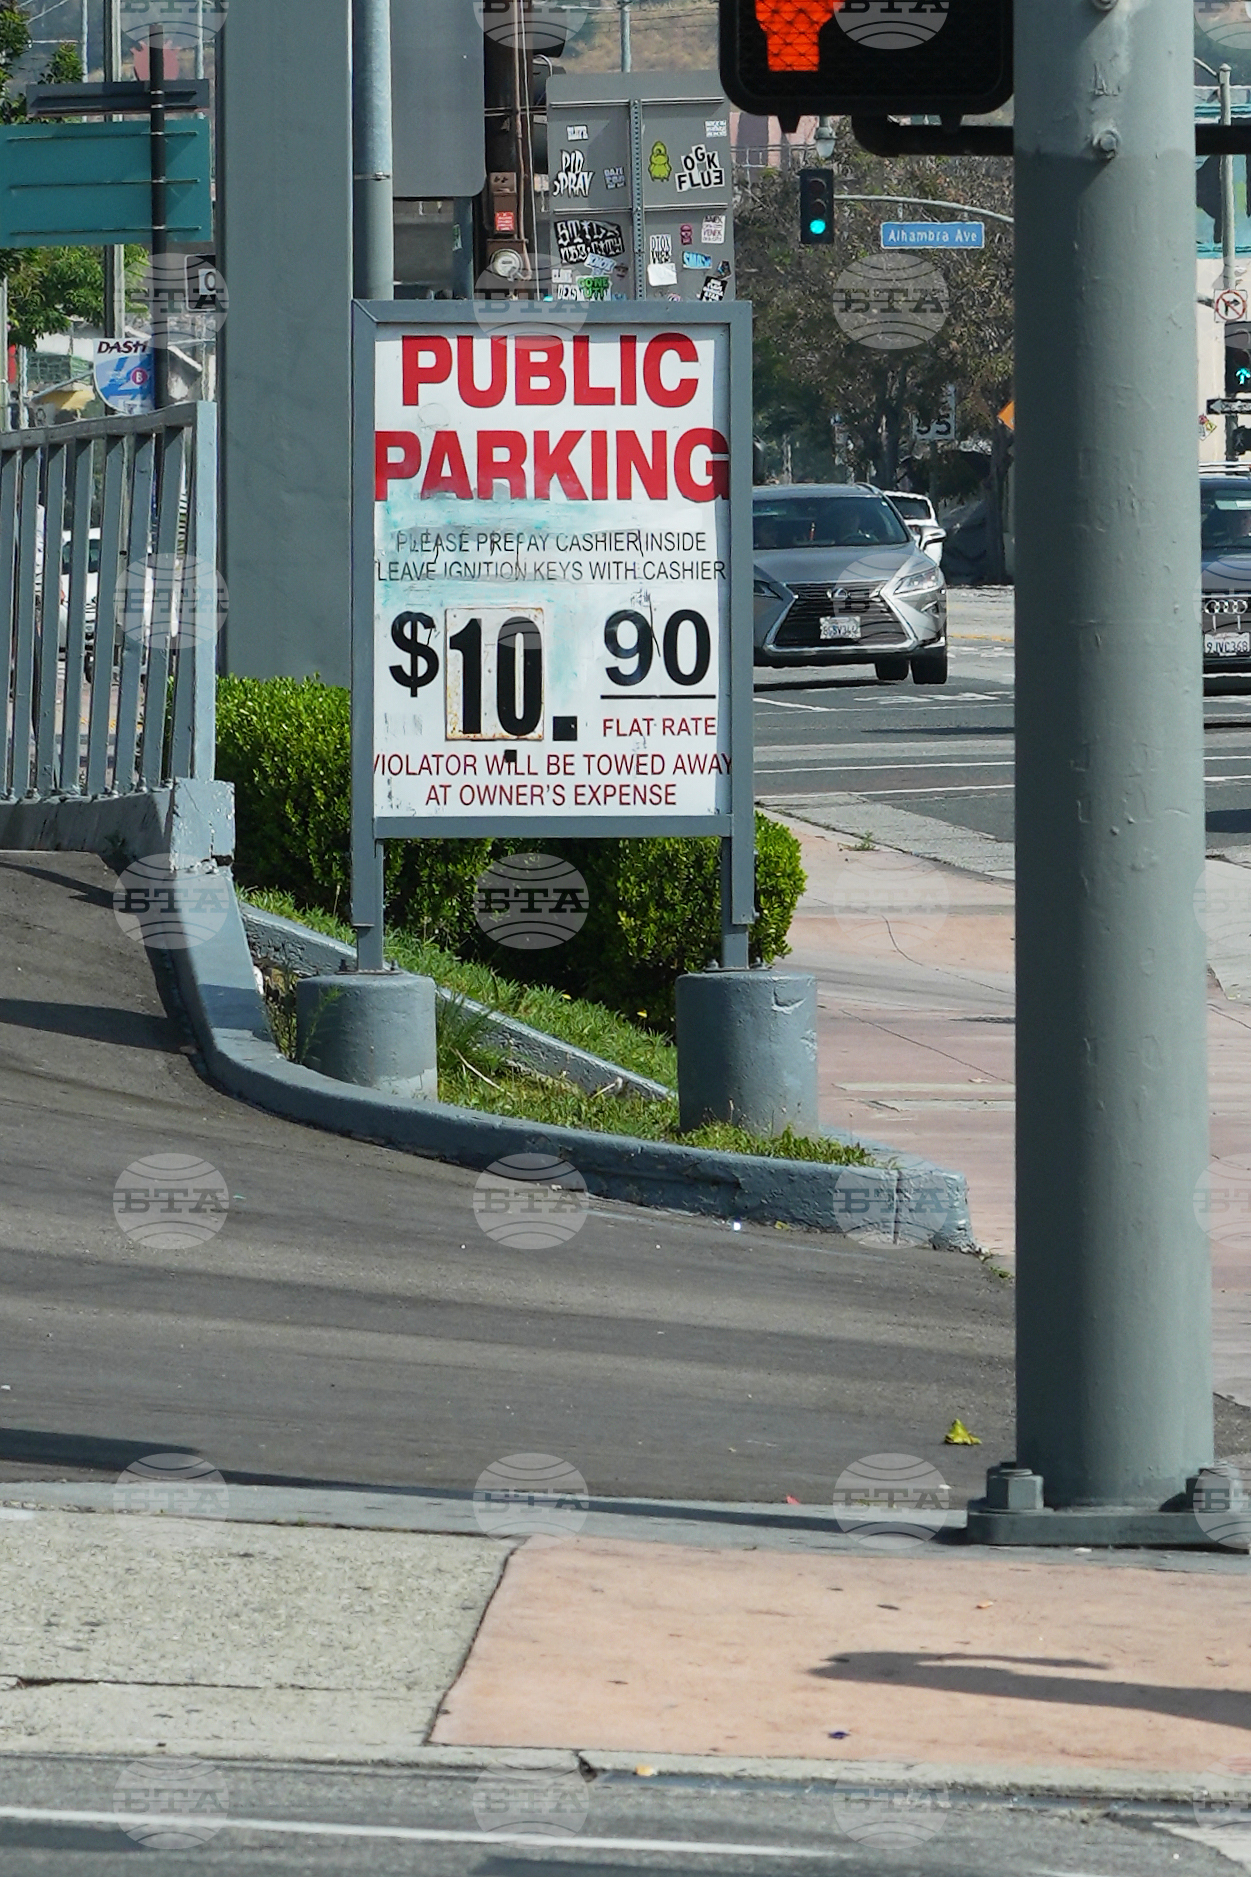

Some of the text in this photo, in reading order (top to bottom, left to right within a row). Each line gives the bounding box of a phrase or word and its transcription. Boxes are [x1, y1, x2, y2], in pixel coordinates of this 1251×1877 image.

[887, 229, 977, 242] Alhambra Ave
[97, 340, 149, 355] DASH
[402, 333, 701, 407] PUBLIC
[374, 427, 730, 504] PARKING
[396, 531, 470, 553] PLEASE
[556, 531, 639, 552] CASHIER
[645, 531, 707, 552] INSIDE
[377, 560, 726, 581] LEAVE IGNITION KEYS WITH CASHIER
[602, 717, 718, 737] FLAT RATE
[484, 754, 539, 776] WILL
[546, 753, 575, 776] BE
[582, 753, 666, 776] TOWED
[672, 752, 732, 776] AWAY
[425, 783, 678, 806] AT OWNER'S EXPENSE
